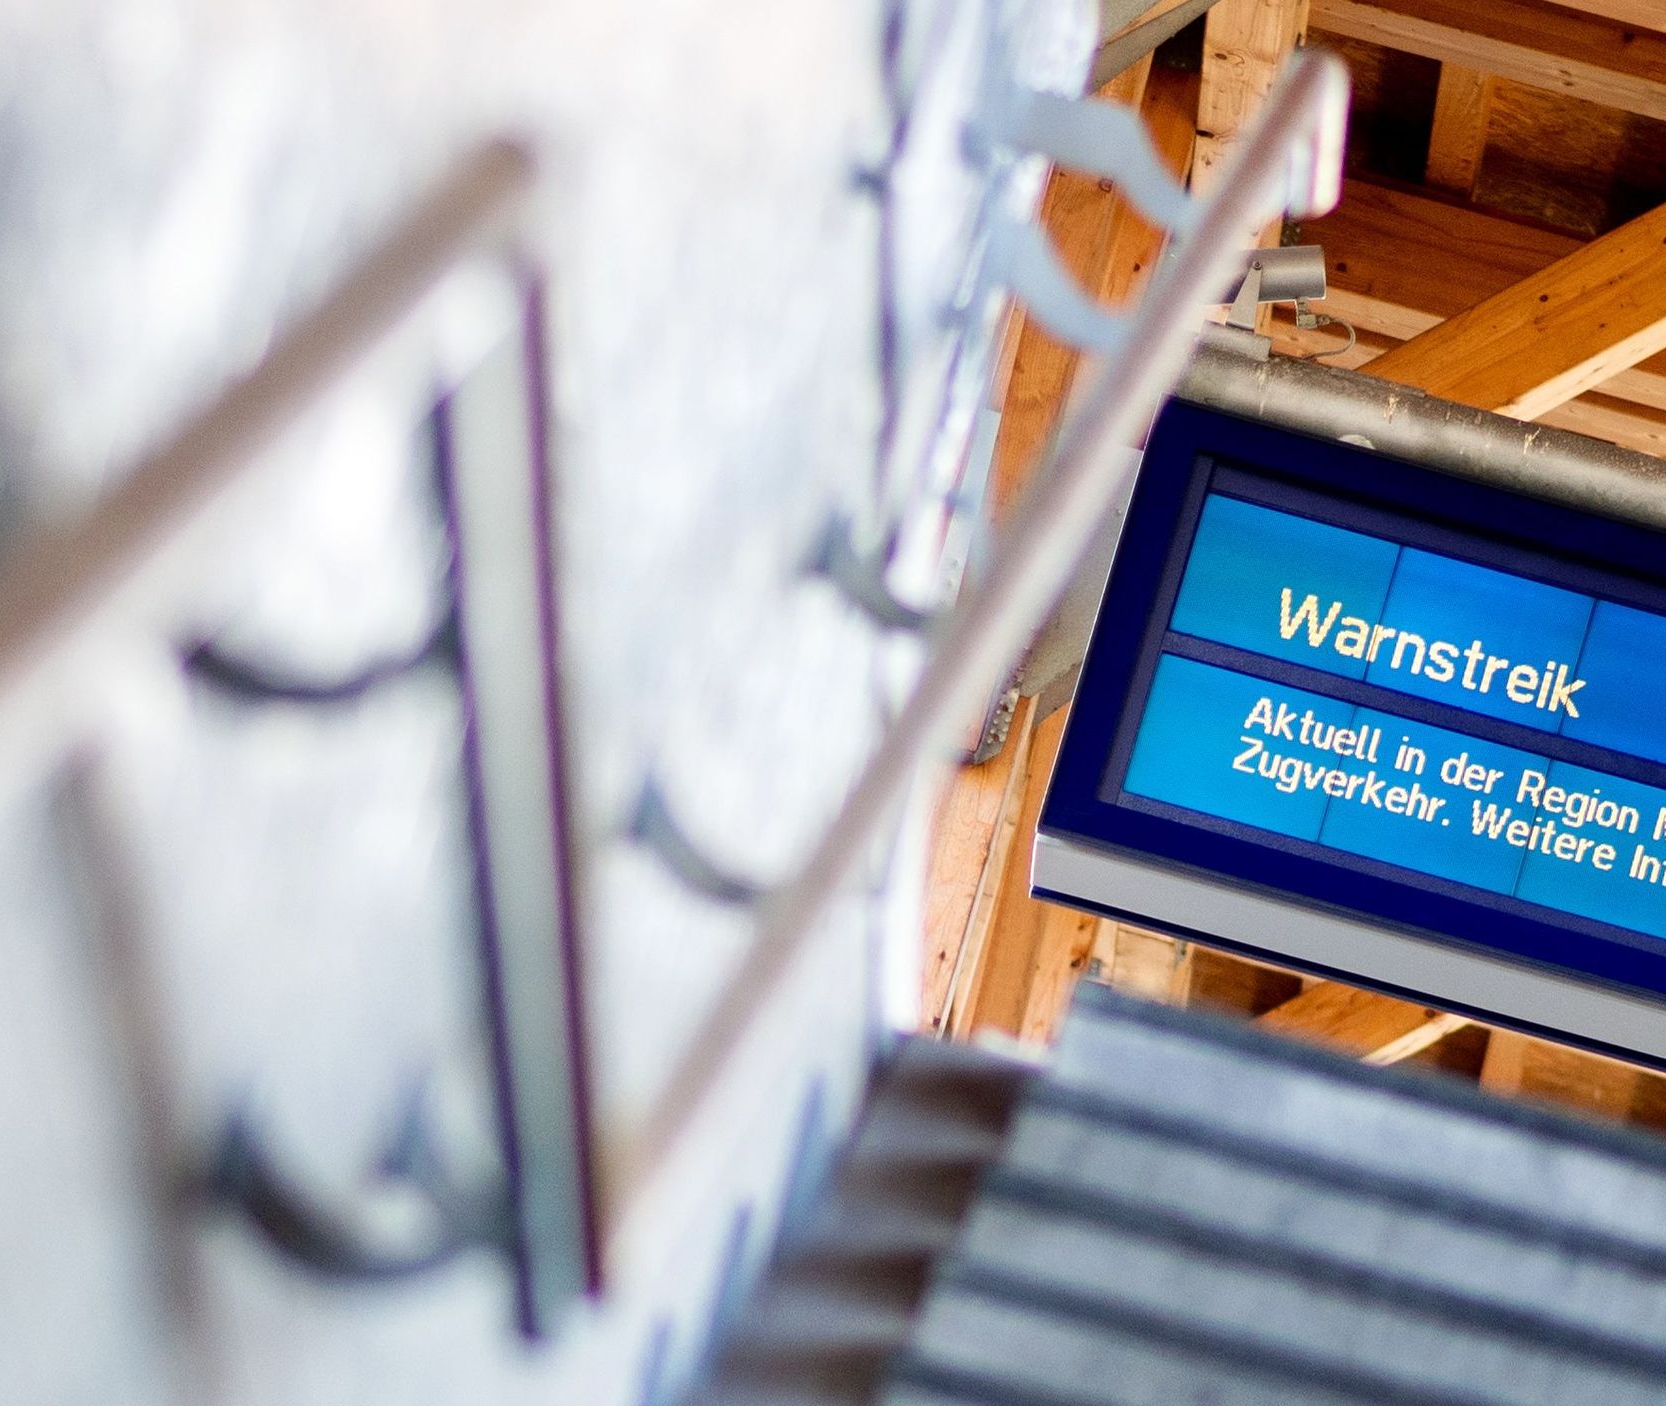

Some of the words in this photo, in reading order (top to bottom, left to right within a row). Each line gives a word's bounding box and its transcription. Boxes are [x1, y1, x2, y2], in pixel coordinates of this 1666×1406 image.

[1280, 587, 1587, 719] Warnstreik
[1232, 735, 1450, 826] Zugverkehr.
[1471, 799, 1617, 871] Weitere
[1244, 697, 1382, 764] Aktuell
[1395, 736, 1426, 776] in
[1440, 752, 1505, 794] der
[1516, 769, 1640, 834] Region
